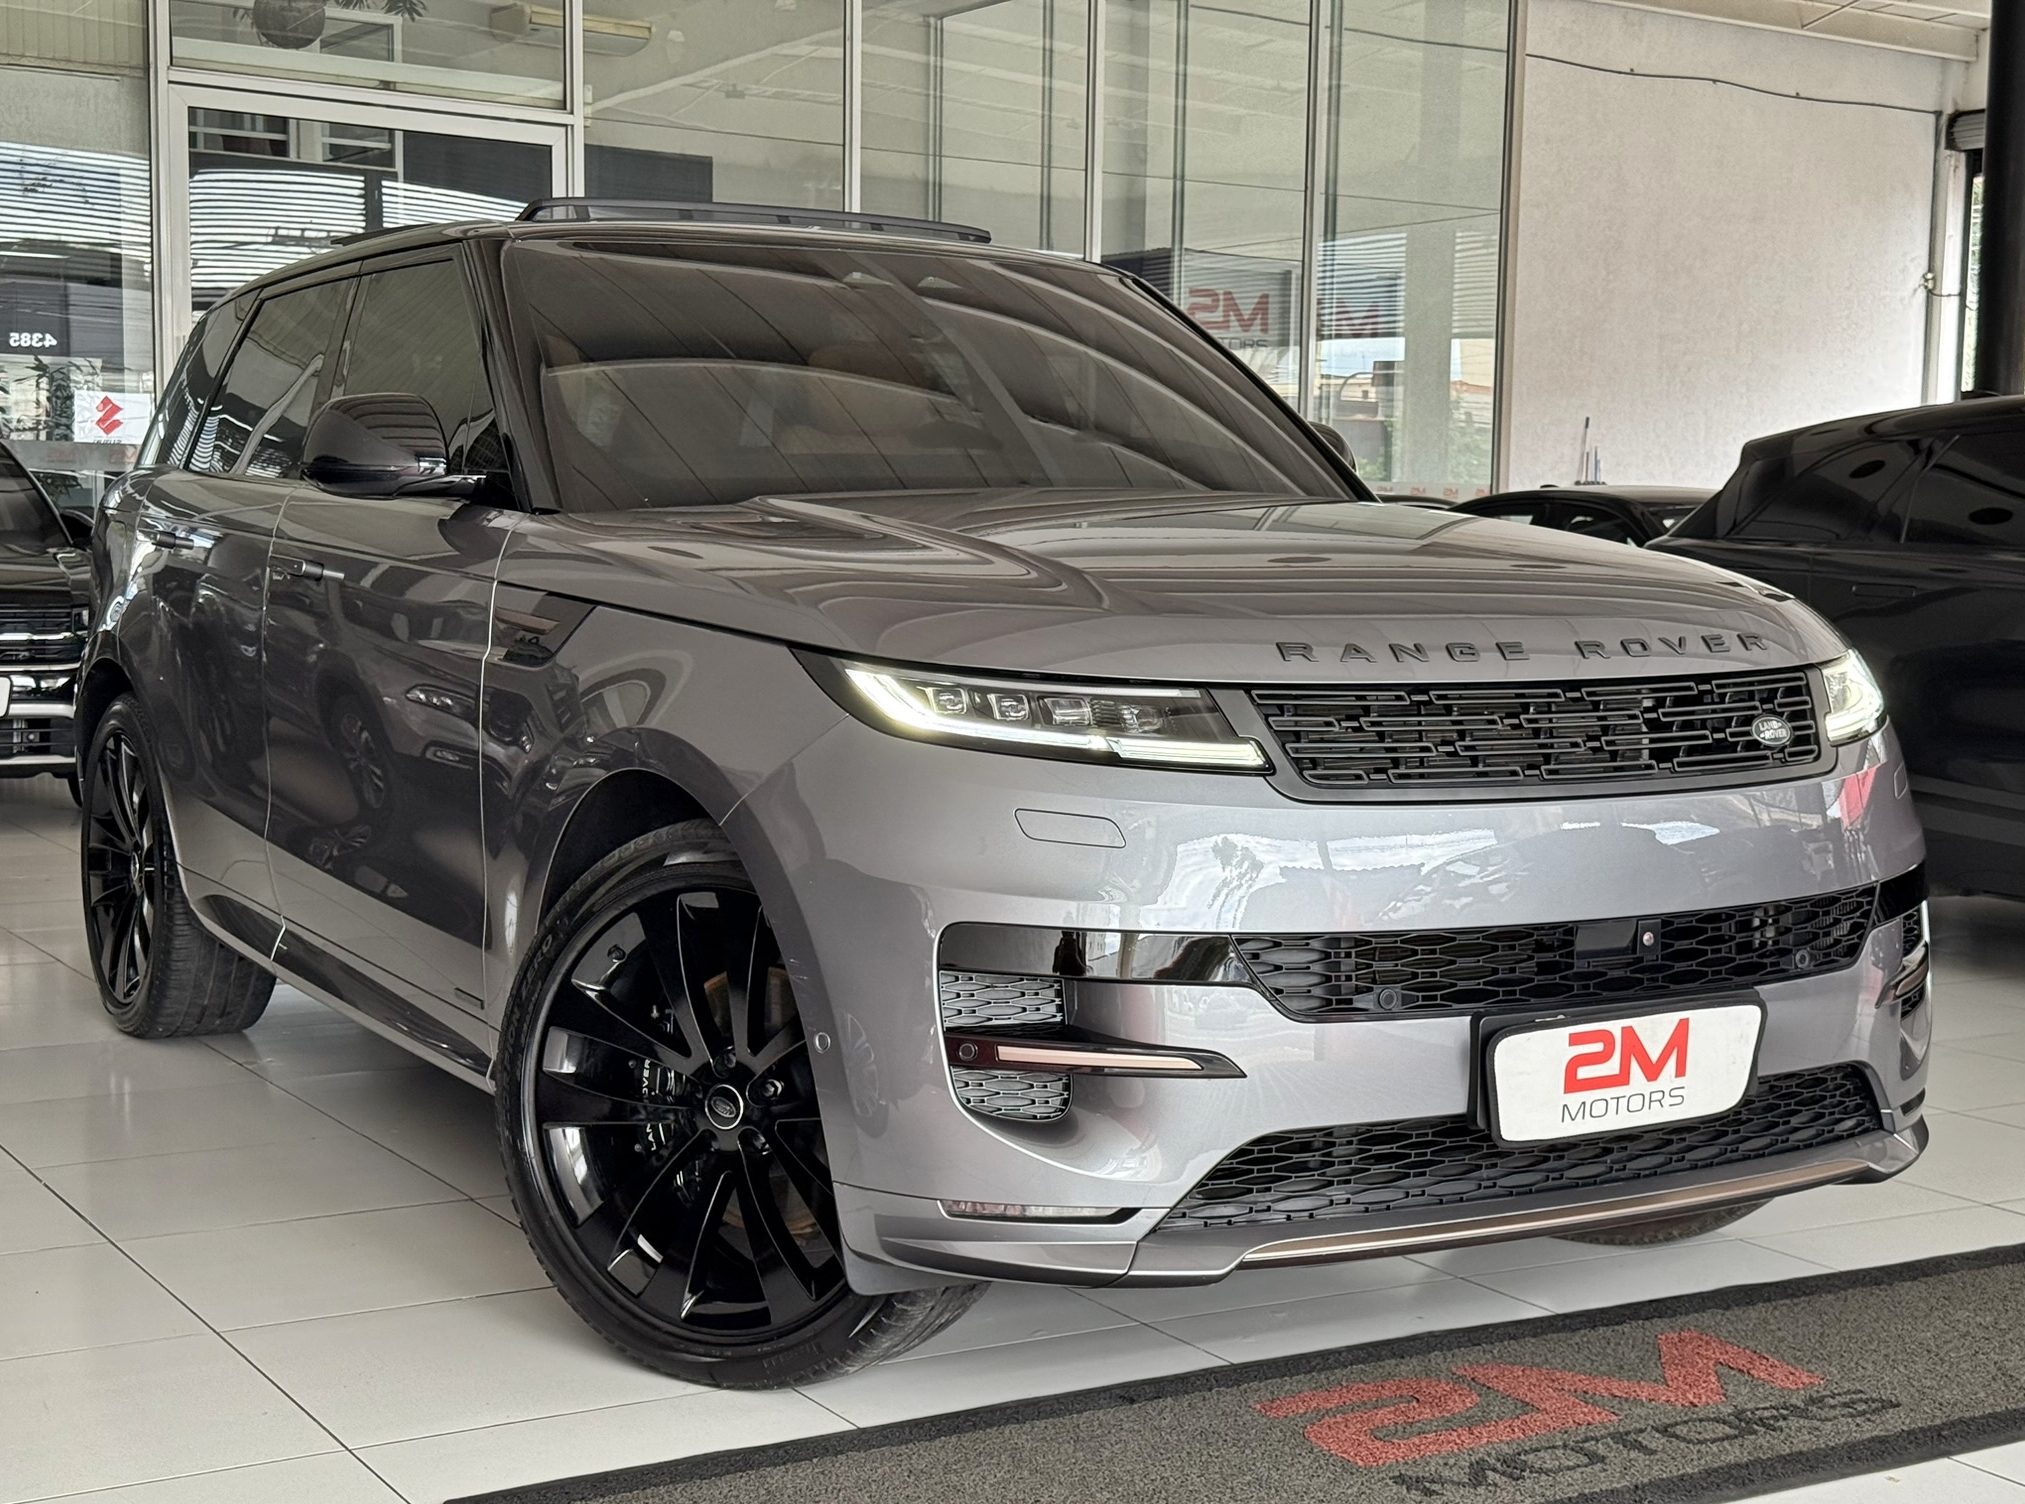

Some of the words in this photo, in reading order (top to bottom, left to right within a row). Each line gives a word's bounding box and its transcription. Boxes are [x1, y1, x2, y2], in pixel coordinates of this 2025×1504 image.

[1216, 337, 1268, 350] TORS
[1276, 640, 1530, 663] RANGE
[1574, 632, 1769, 660] ROVER
[1759, 720, 1779, 731] LAND
[1764, 728, 1788, 740] ROVER
[1563, 1017, 1690, 1095] 2M
[1561, 1086, 1686, 1124] MOTORS
[1252, 1329, 1825, 1468] 2M
